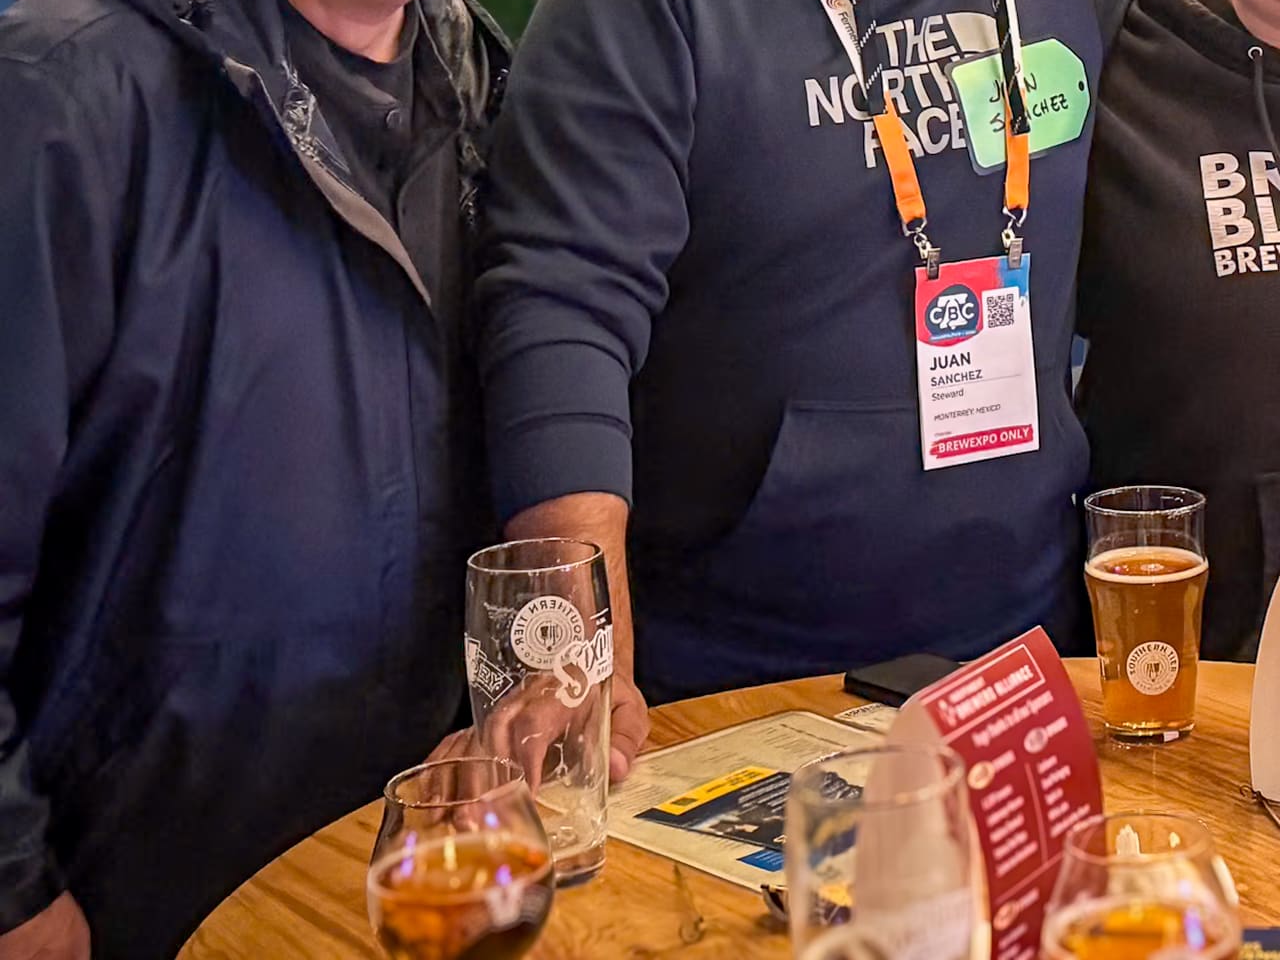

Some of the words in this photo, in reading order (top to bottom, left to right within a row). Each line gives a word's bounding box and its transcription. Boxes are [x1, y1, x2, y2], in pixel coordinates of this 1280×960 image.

[876, 14, 957, 67] THE
[929, 301, 976, 325] CBC
[930, 351, 971, 371] JUAN
[930, 369, 983, 387] SANCHEZ
[932, 388, 964, 402] Steward
[938, 433, 998, 454] BREWEXPO
[1000, 427, 1030, 444] ONLY
[1129, 643, 1168, 675] SOUTHERN
